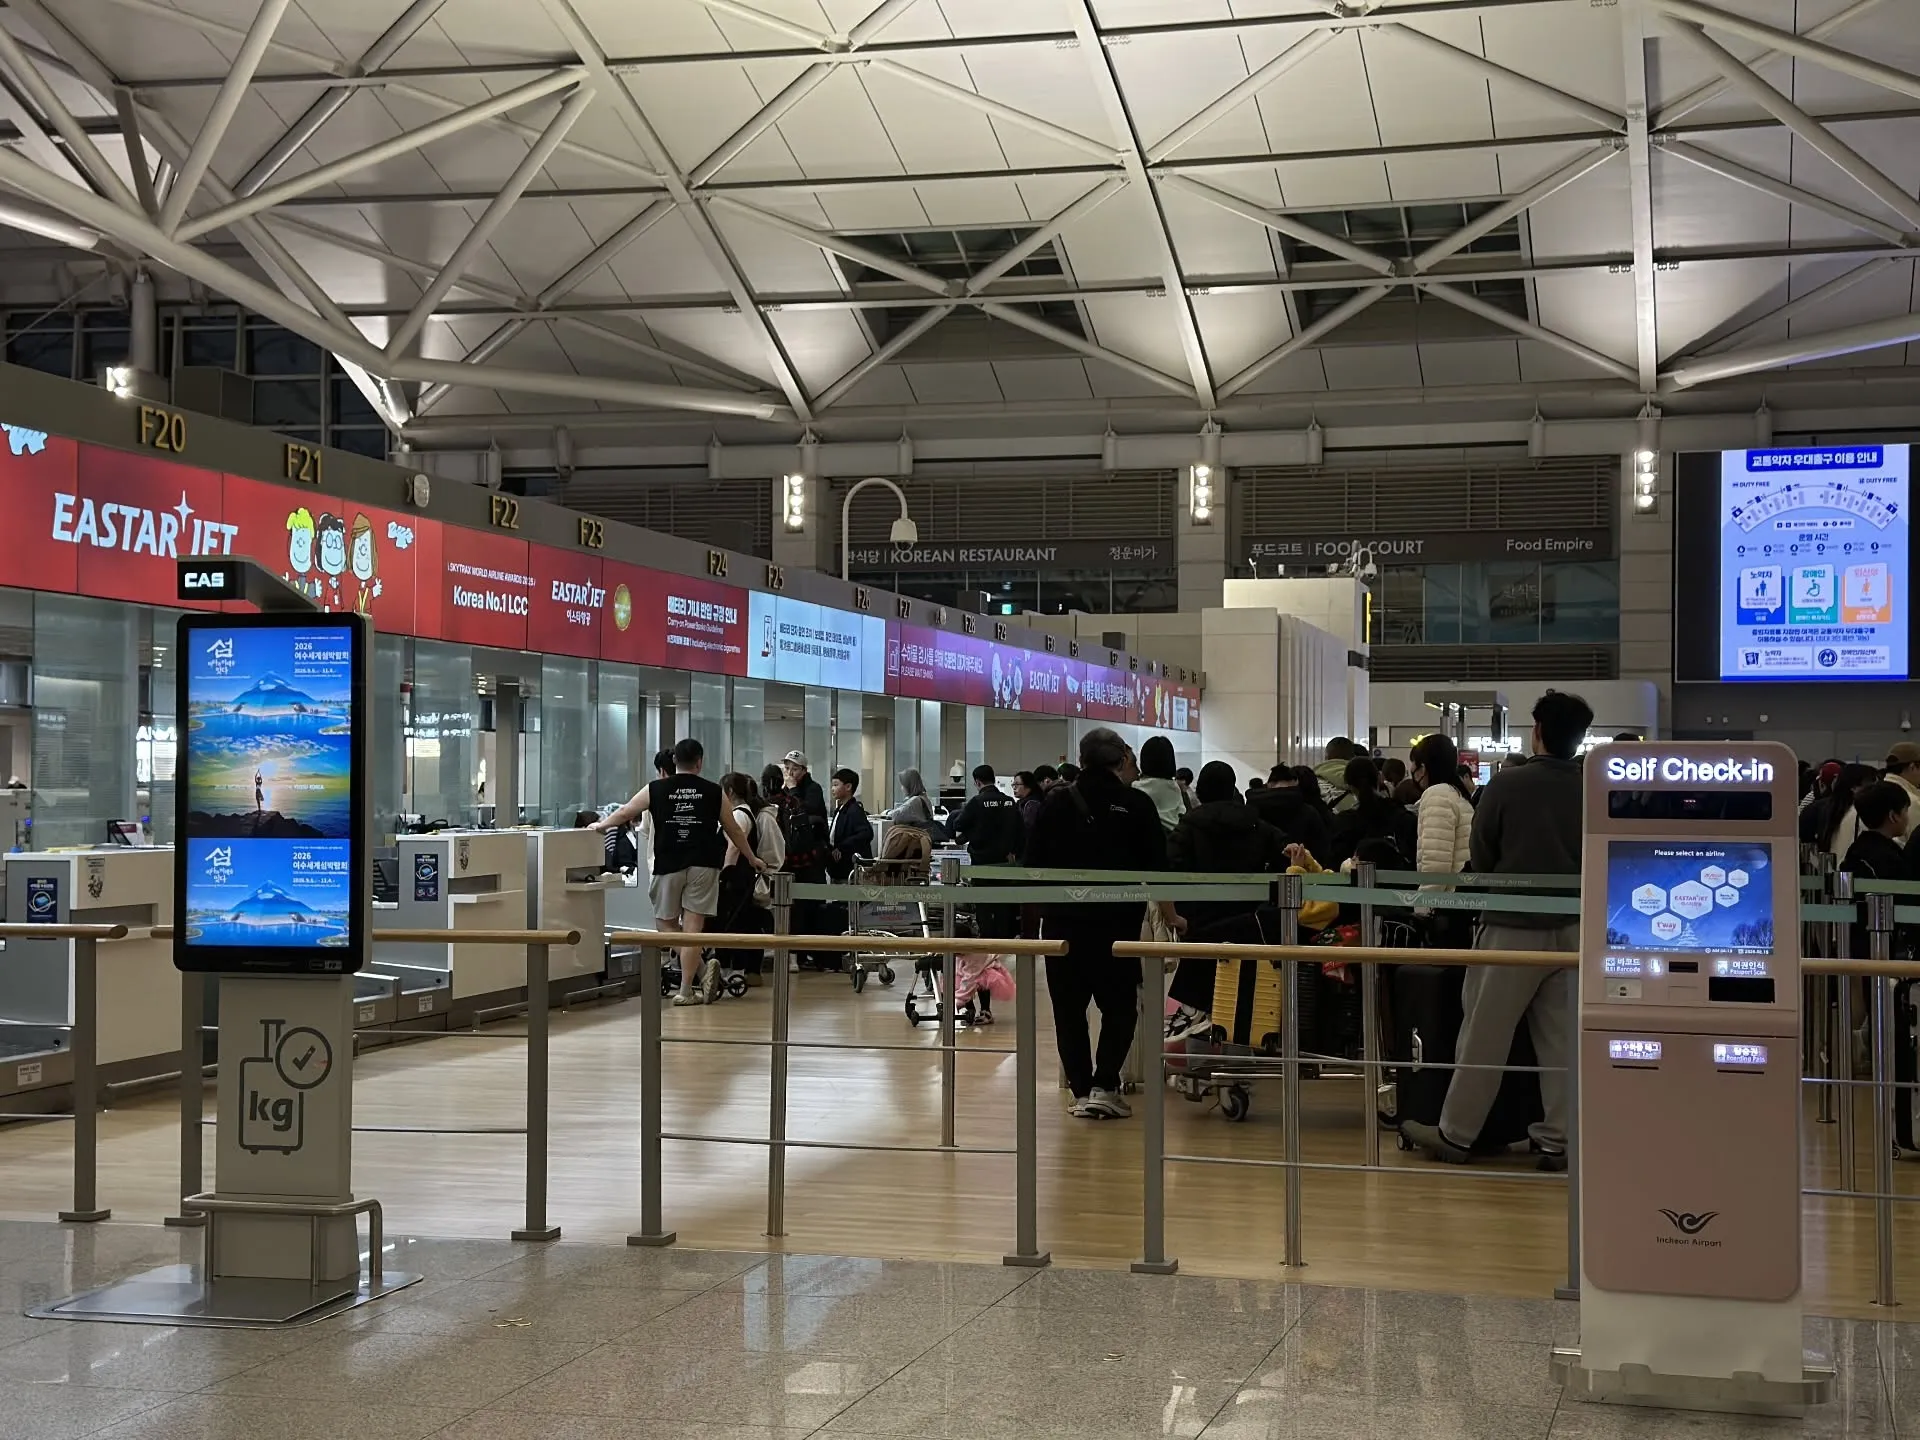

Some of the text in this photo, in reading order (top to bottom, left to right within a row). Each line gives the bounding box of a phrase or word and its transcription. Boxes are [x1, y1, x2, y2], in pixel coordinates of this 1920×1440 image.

[138, 406, 187, 454] F20
[285, 443, 323, 484] F21
[1834, 453, 1855, 464] 이용
[1857, 452, 1878, 464] 안내
[490, 495, 520, 530] F22
[52, 492, 178, 558] EASTAR
[579, 518, 604, 550] F23
[890, 547, 1057, 565] KOREAN RESTAURANT
[1251, 543, 1304, 557] 푸드코트
[1316, 540, 1424, 556] FOO COURT
[1506, 538, 1594, 554] Food Empire
[450, 562, 472, 575] SKYTRAX
[472, 566, 488, 578] WORLD
[488, 569, 504, 581] AIRLINE
[710, 550, 728, 577] F24
[184, 572, 224, 587] CAS
[767, 565, 784, 590] F25
[454, 585, 528, 616] Korea No.1 LCC
[552, 580, 606, 608] EASTAR JET
[856, 586, 870, 610] F26
[898, 598, 912, 619] F27
[964, 614, 976, 634] F28
[206, 637, 233, 658] 섬
[1030, 670, 1060, 694] EASTAR JET
[1608, 757, 1774, 782] Self Check-in
[204, 846, 232, 867] 섬
[915, 890, 942, 900] Airport
[1123, 890, 1152, 901] Airport
[1422, 897, 1456, 906] Incheon
[1617, 958, 1640, 966] 바코드
[1732, 960, 1765, 969] 여권인식
[249, 1090, 293, 1132] kg
[1656, 1236, 1722, 1247] Incheon Airport
